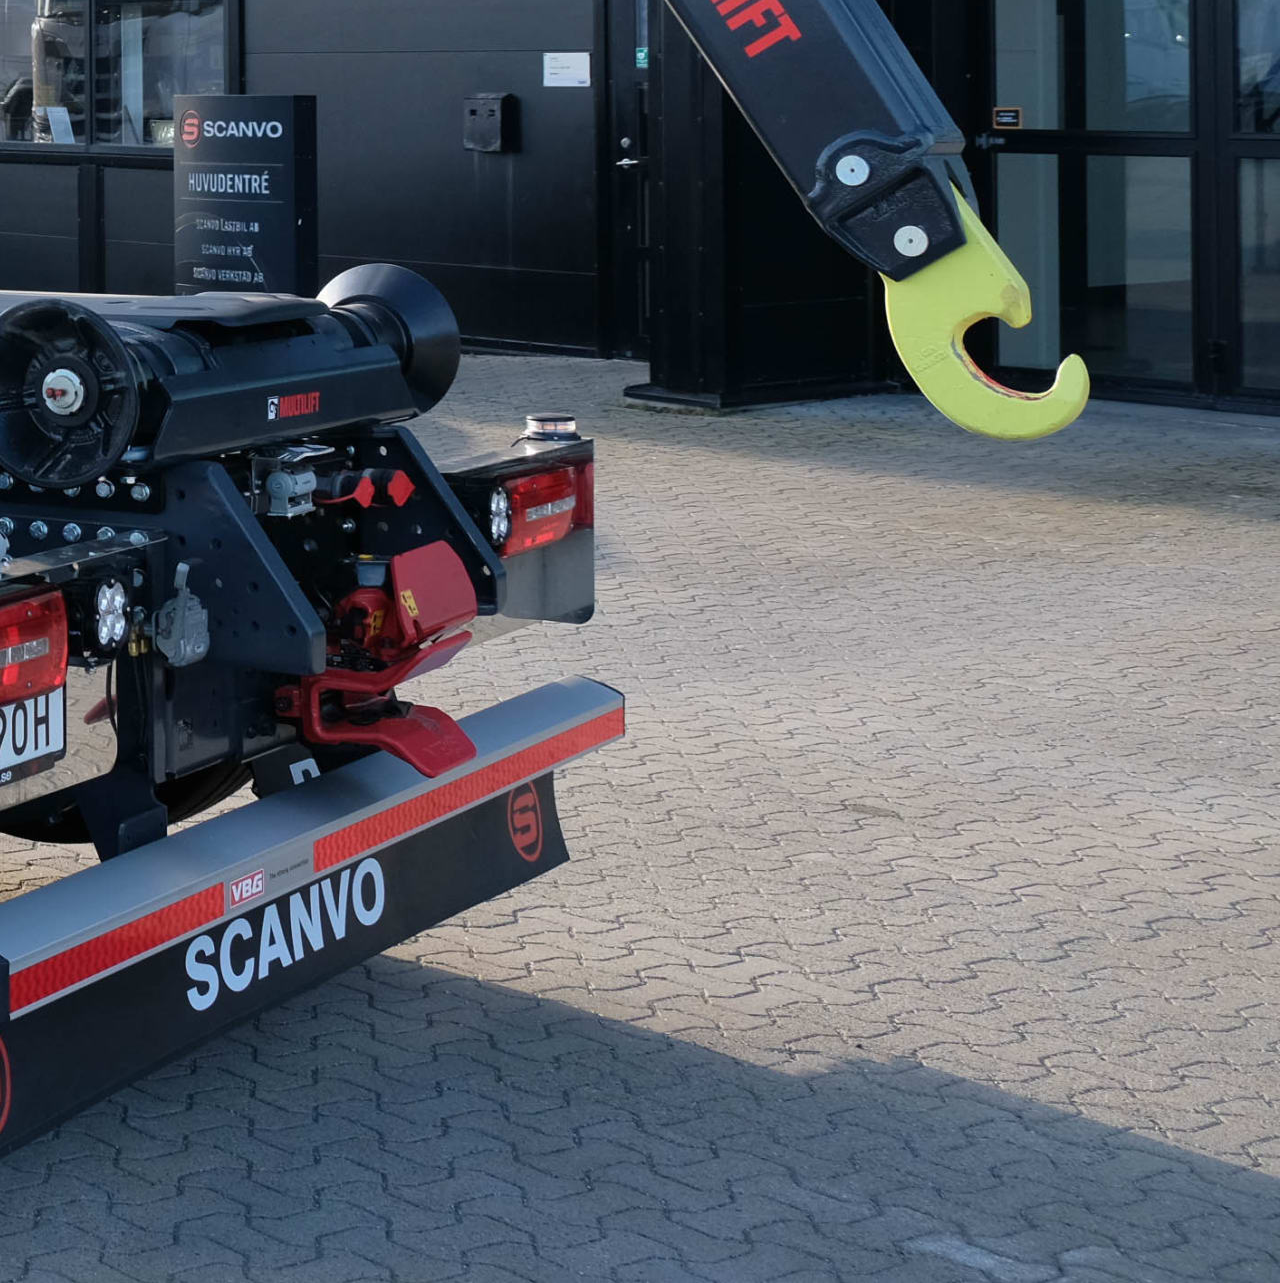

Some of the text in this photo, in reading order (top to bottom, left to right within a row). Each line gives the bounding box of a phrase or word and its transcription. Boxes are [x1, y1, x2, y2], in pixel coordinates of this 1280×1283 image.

[203, 121, 283, 138] SCANVO
[188, 171, 270, 194] HUVUDENTRÉ
[249, 222, 259, 232] AB
[253, 272, 264, 283] AB
[279, 391, 321, 418] MULTILIFT
[231, 873, 263, 902] VBG
[185, 857, 386, 1012] SCANVO
